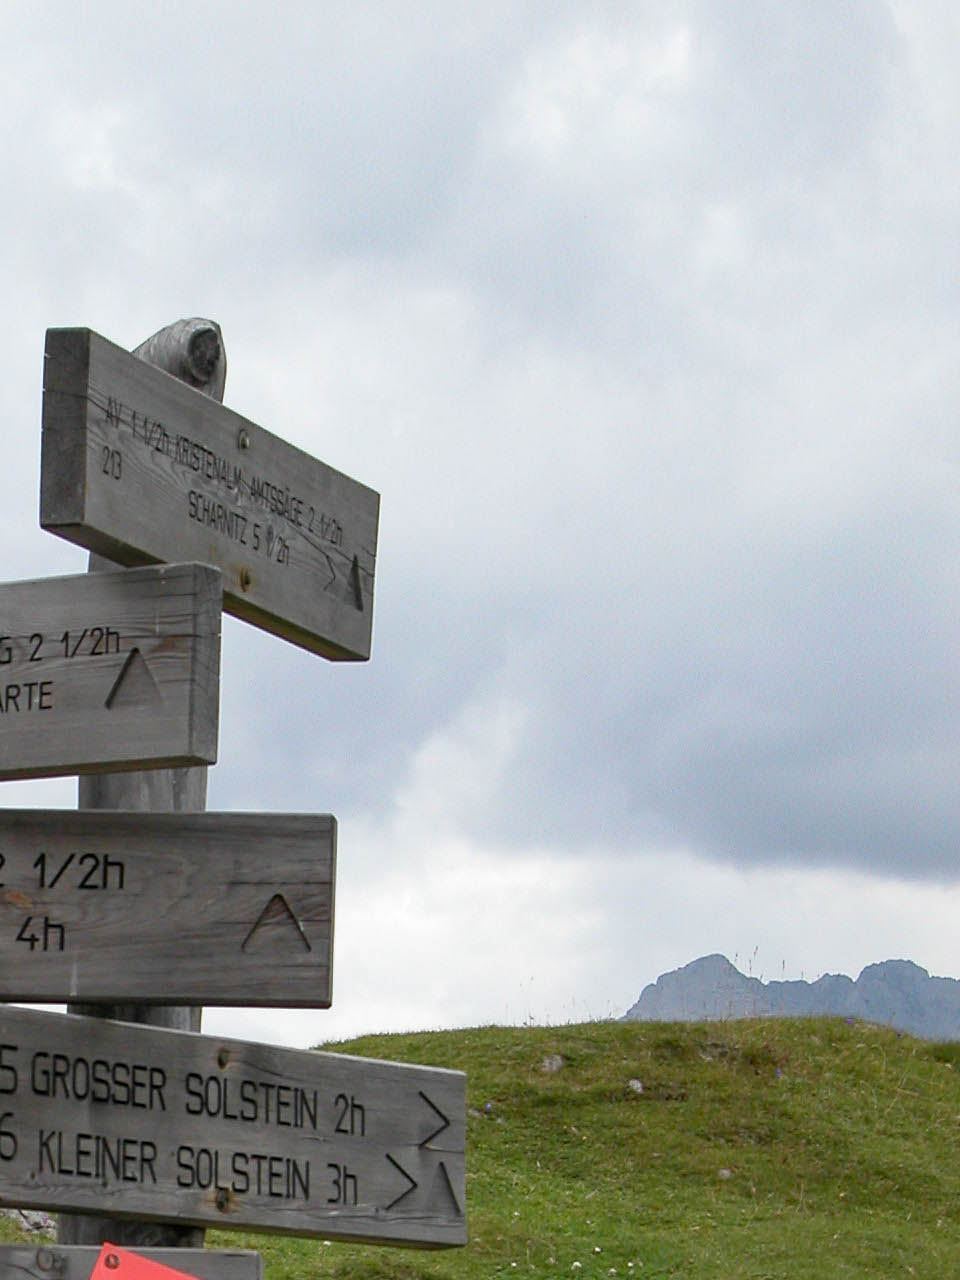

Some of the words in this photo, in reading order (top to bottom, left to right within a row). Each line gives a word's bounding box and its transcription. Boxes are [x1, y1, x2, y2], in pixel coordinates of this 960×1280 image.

[102, 445, 123, 481] 213
[189, 491, 247, 546] SCHARNITZ
[252, 524, 261, 551] 5
[105, 396, 122, 429] AV
[308, 506, 316, 534] 2
[320, 512, 343, 547] 1/2h
[29, 633, 44, 663] 2
[60, 626, 121, 659] 1/2h
[33, 852, 125, 890] 1/2h
[16, 915, 66, 952] 4h
[31, 1050, 167, 1111] GROSSER
[185, 1072, 318, 1131] SOLSTEIN
[334, 1093, 366, 1136] 2h
[39, 1129, 158, 1185] KLEINER
[177, 1145, 310, 1199] SOLSTEIN
[327, 1163, 358, 1206] 3h
